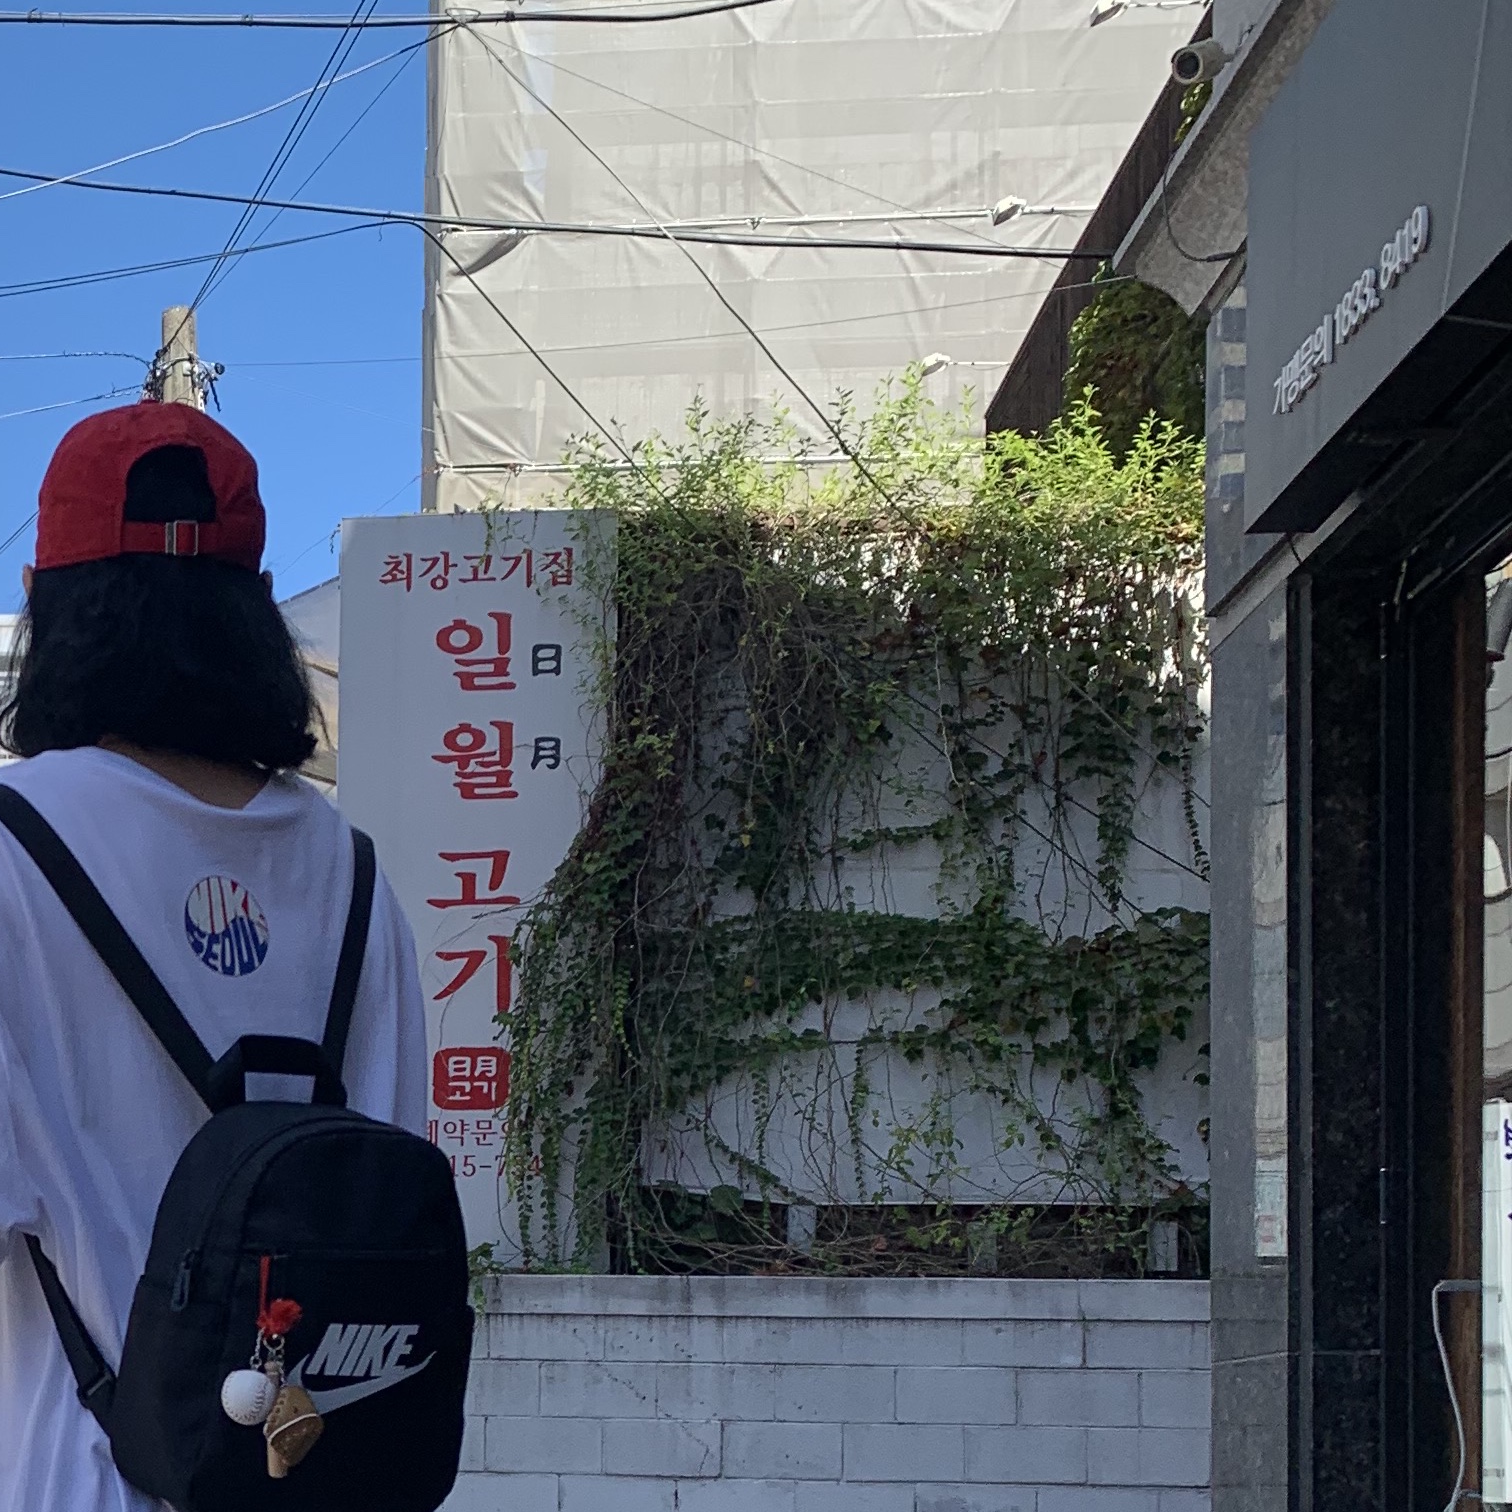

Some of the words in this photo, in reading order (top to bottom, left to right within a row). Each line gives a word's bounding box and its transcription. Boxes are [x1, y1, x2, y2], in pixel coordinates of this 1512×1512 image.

[1272, 314, 1334, 415] 가맹문의
[379, 547, 574, 592] 최강고기집
[447, 1080, 497, 1102] 고기
[305, 1323, 420, 1378] NIKE
